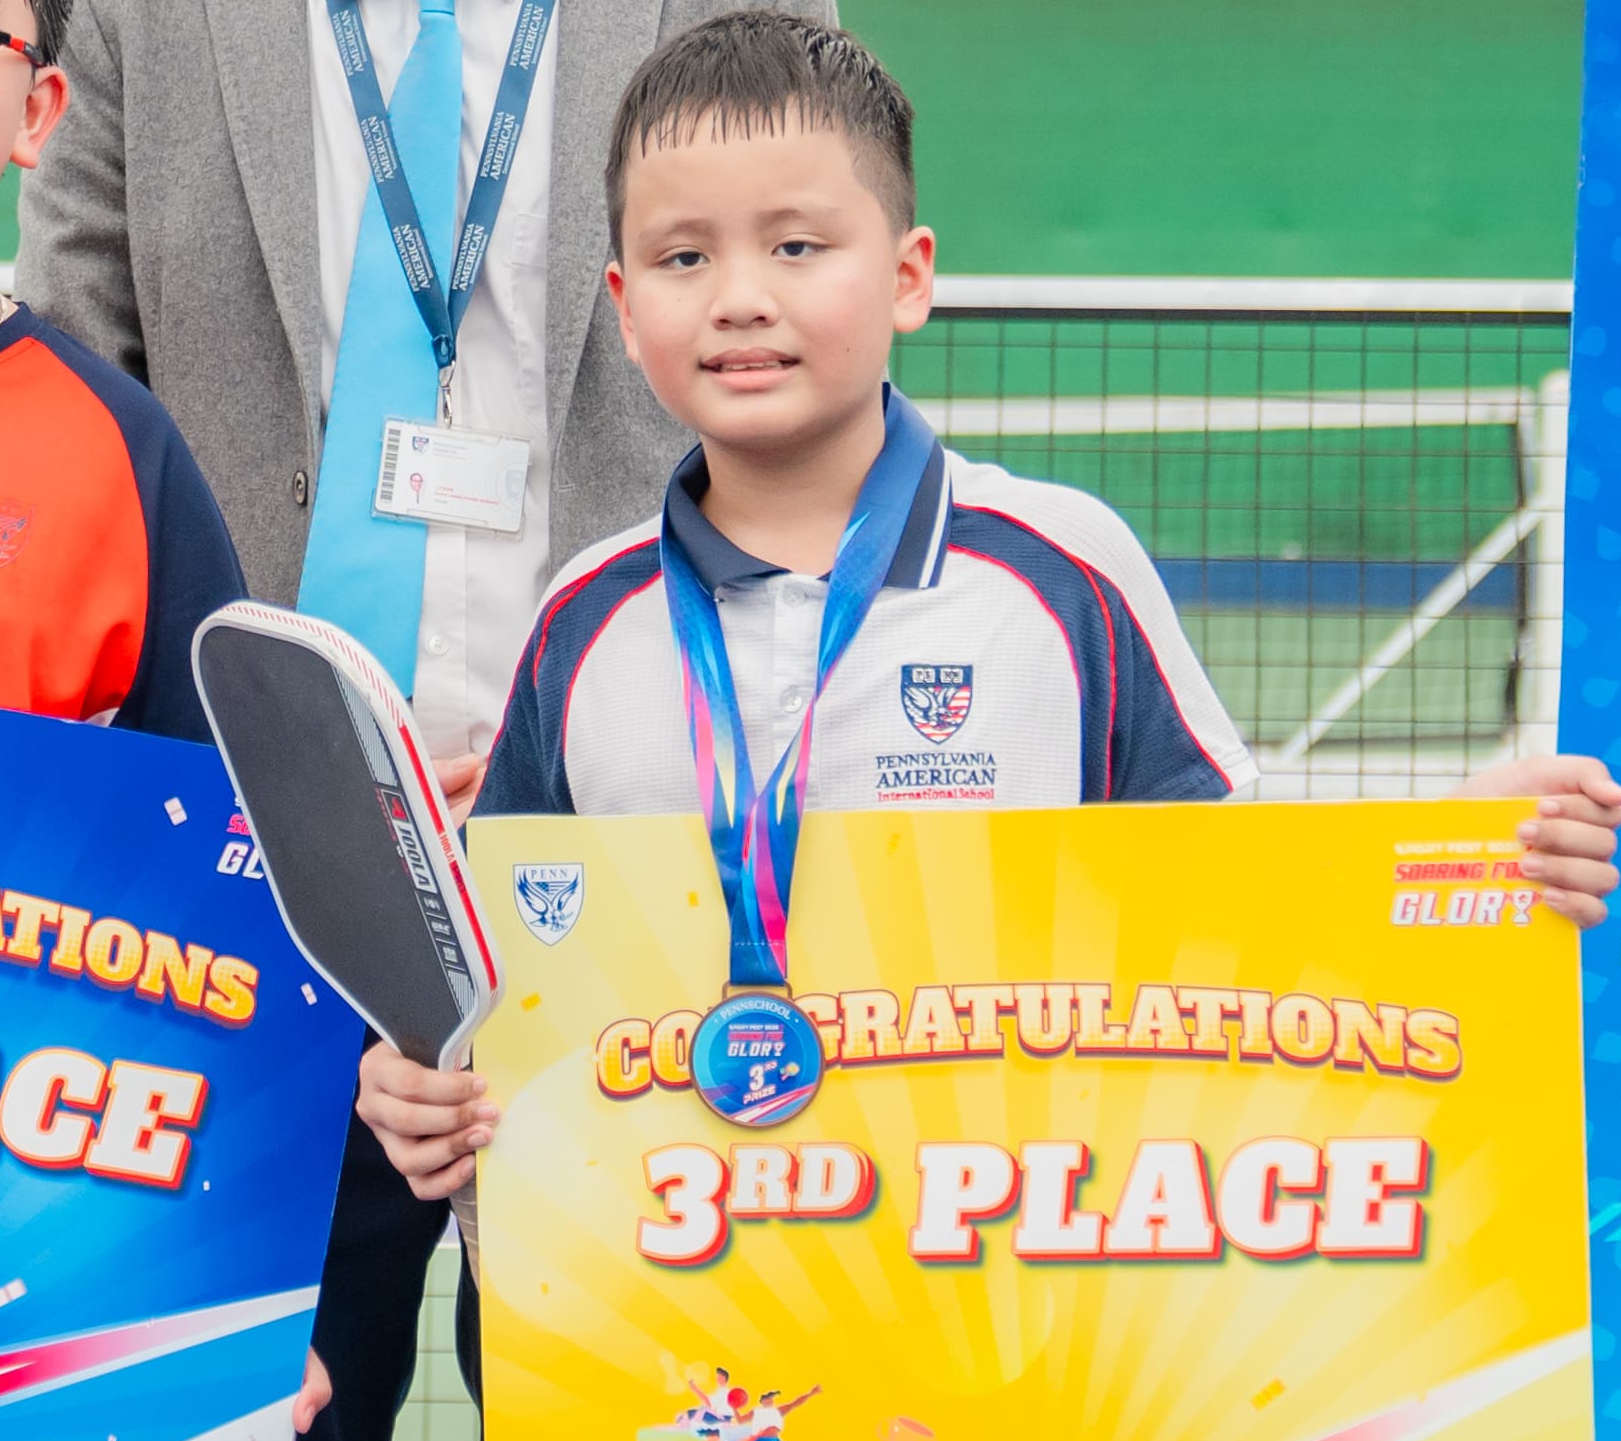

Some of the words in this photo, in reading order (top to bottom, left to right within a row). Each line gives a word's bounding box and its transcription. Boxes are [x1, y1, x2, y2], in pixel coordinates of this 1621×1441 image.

[340, 10, 364, 71] AMERICAN
[519, 5, 544, 70] AMERICAN
[360, 119, 384, 183] PENNSYLVANIA
[368, 116, 395, 179] AMERICAN
[480, 111, 504, 178] PENNSYLVANIA
[490, 113, 516, 180] AMERICAN
[392, 225, 420, 292] PENNSYLVANIA
[401, 224, 431, 289] AMERICAN
[452, 223, 475, 290] PENNSYLVANIA
[460, 224, 485, 291] AMERICAN
[876, 752, 997, 770] PENNSYLVANIA
[876, 768, 997, 789] AMERICAN
[878, 788, 957, 802] International
[959, 787, 995, 800] School
[399, 825, 430, 887] JOOLA
[531, 869, 569, 879] PENN
[1491, 861, 1526, 880] FO
[595, 982, 1463, 1102] COGRATULATIONS
[720, 1000, 791, 1020] PENNSCHOOL
[637, 1137, 875, 1268] 3RD
[906, 1136, 1431, 1264] PLACE
